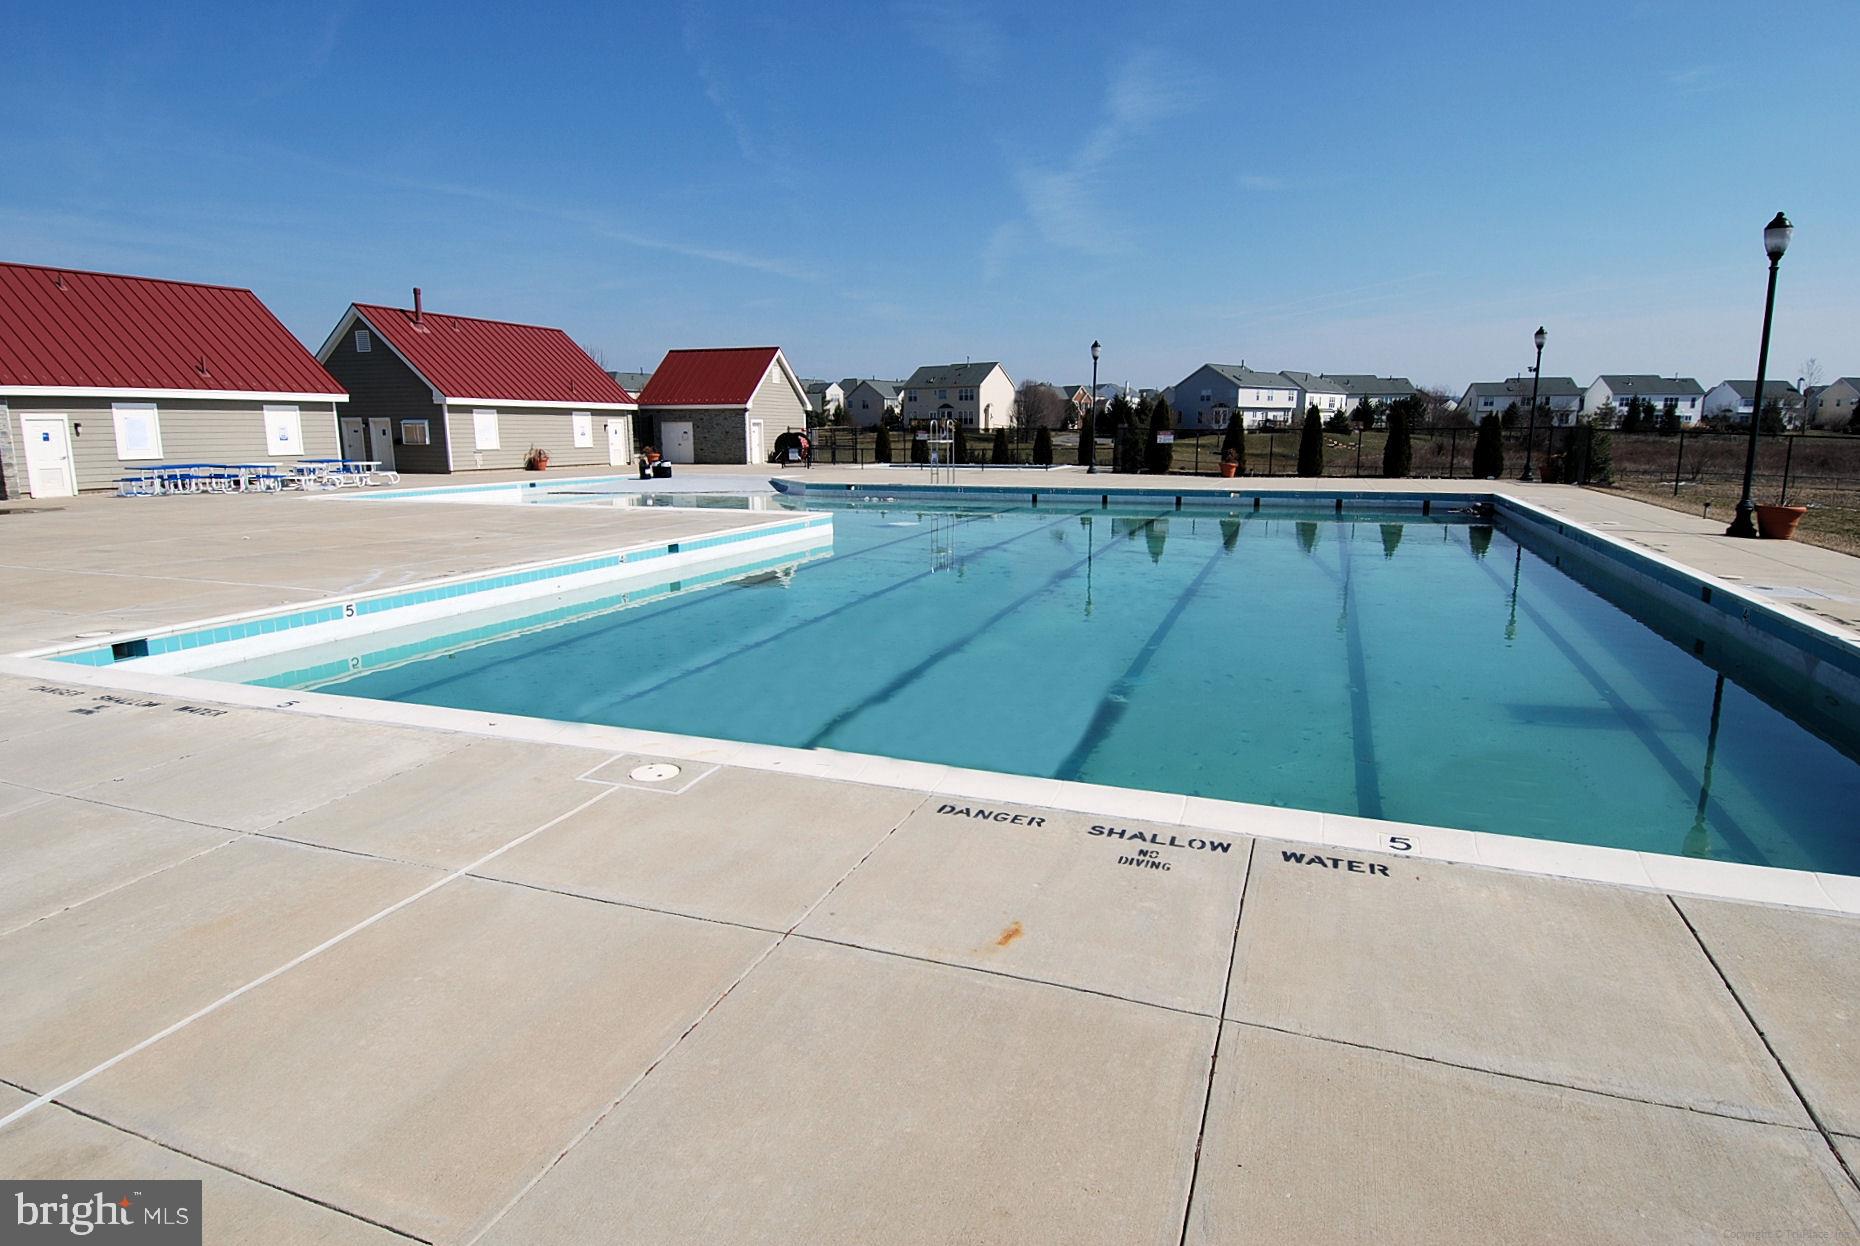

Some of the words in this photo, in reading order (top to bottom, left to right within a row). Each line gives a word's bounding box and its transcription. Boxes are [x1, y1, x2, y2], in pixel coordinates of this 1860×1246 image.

[345, 604, 355, 618] 5
[937, 804, 1046, 828] DANGER
[1087, 825, 1232, 853] SHALLOW
[1281, 850, 1391, 877] WATER
[1389, 836, 1412, 851] 5
[1137, 848, 1160, 859] NO
[1117, 855, 1171, 872] DIVING
